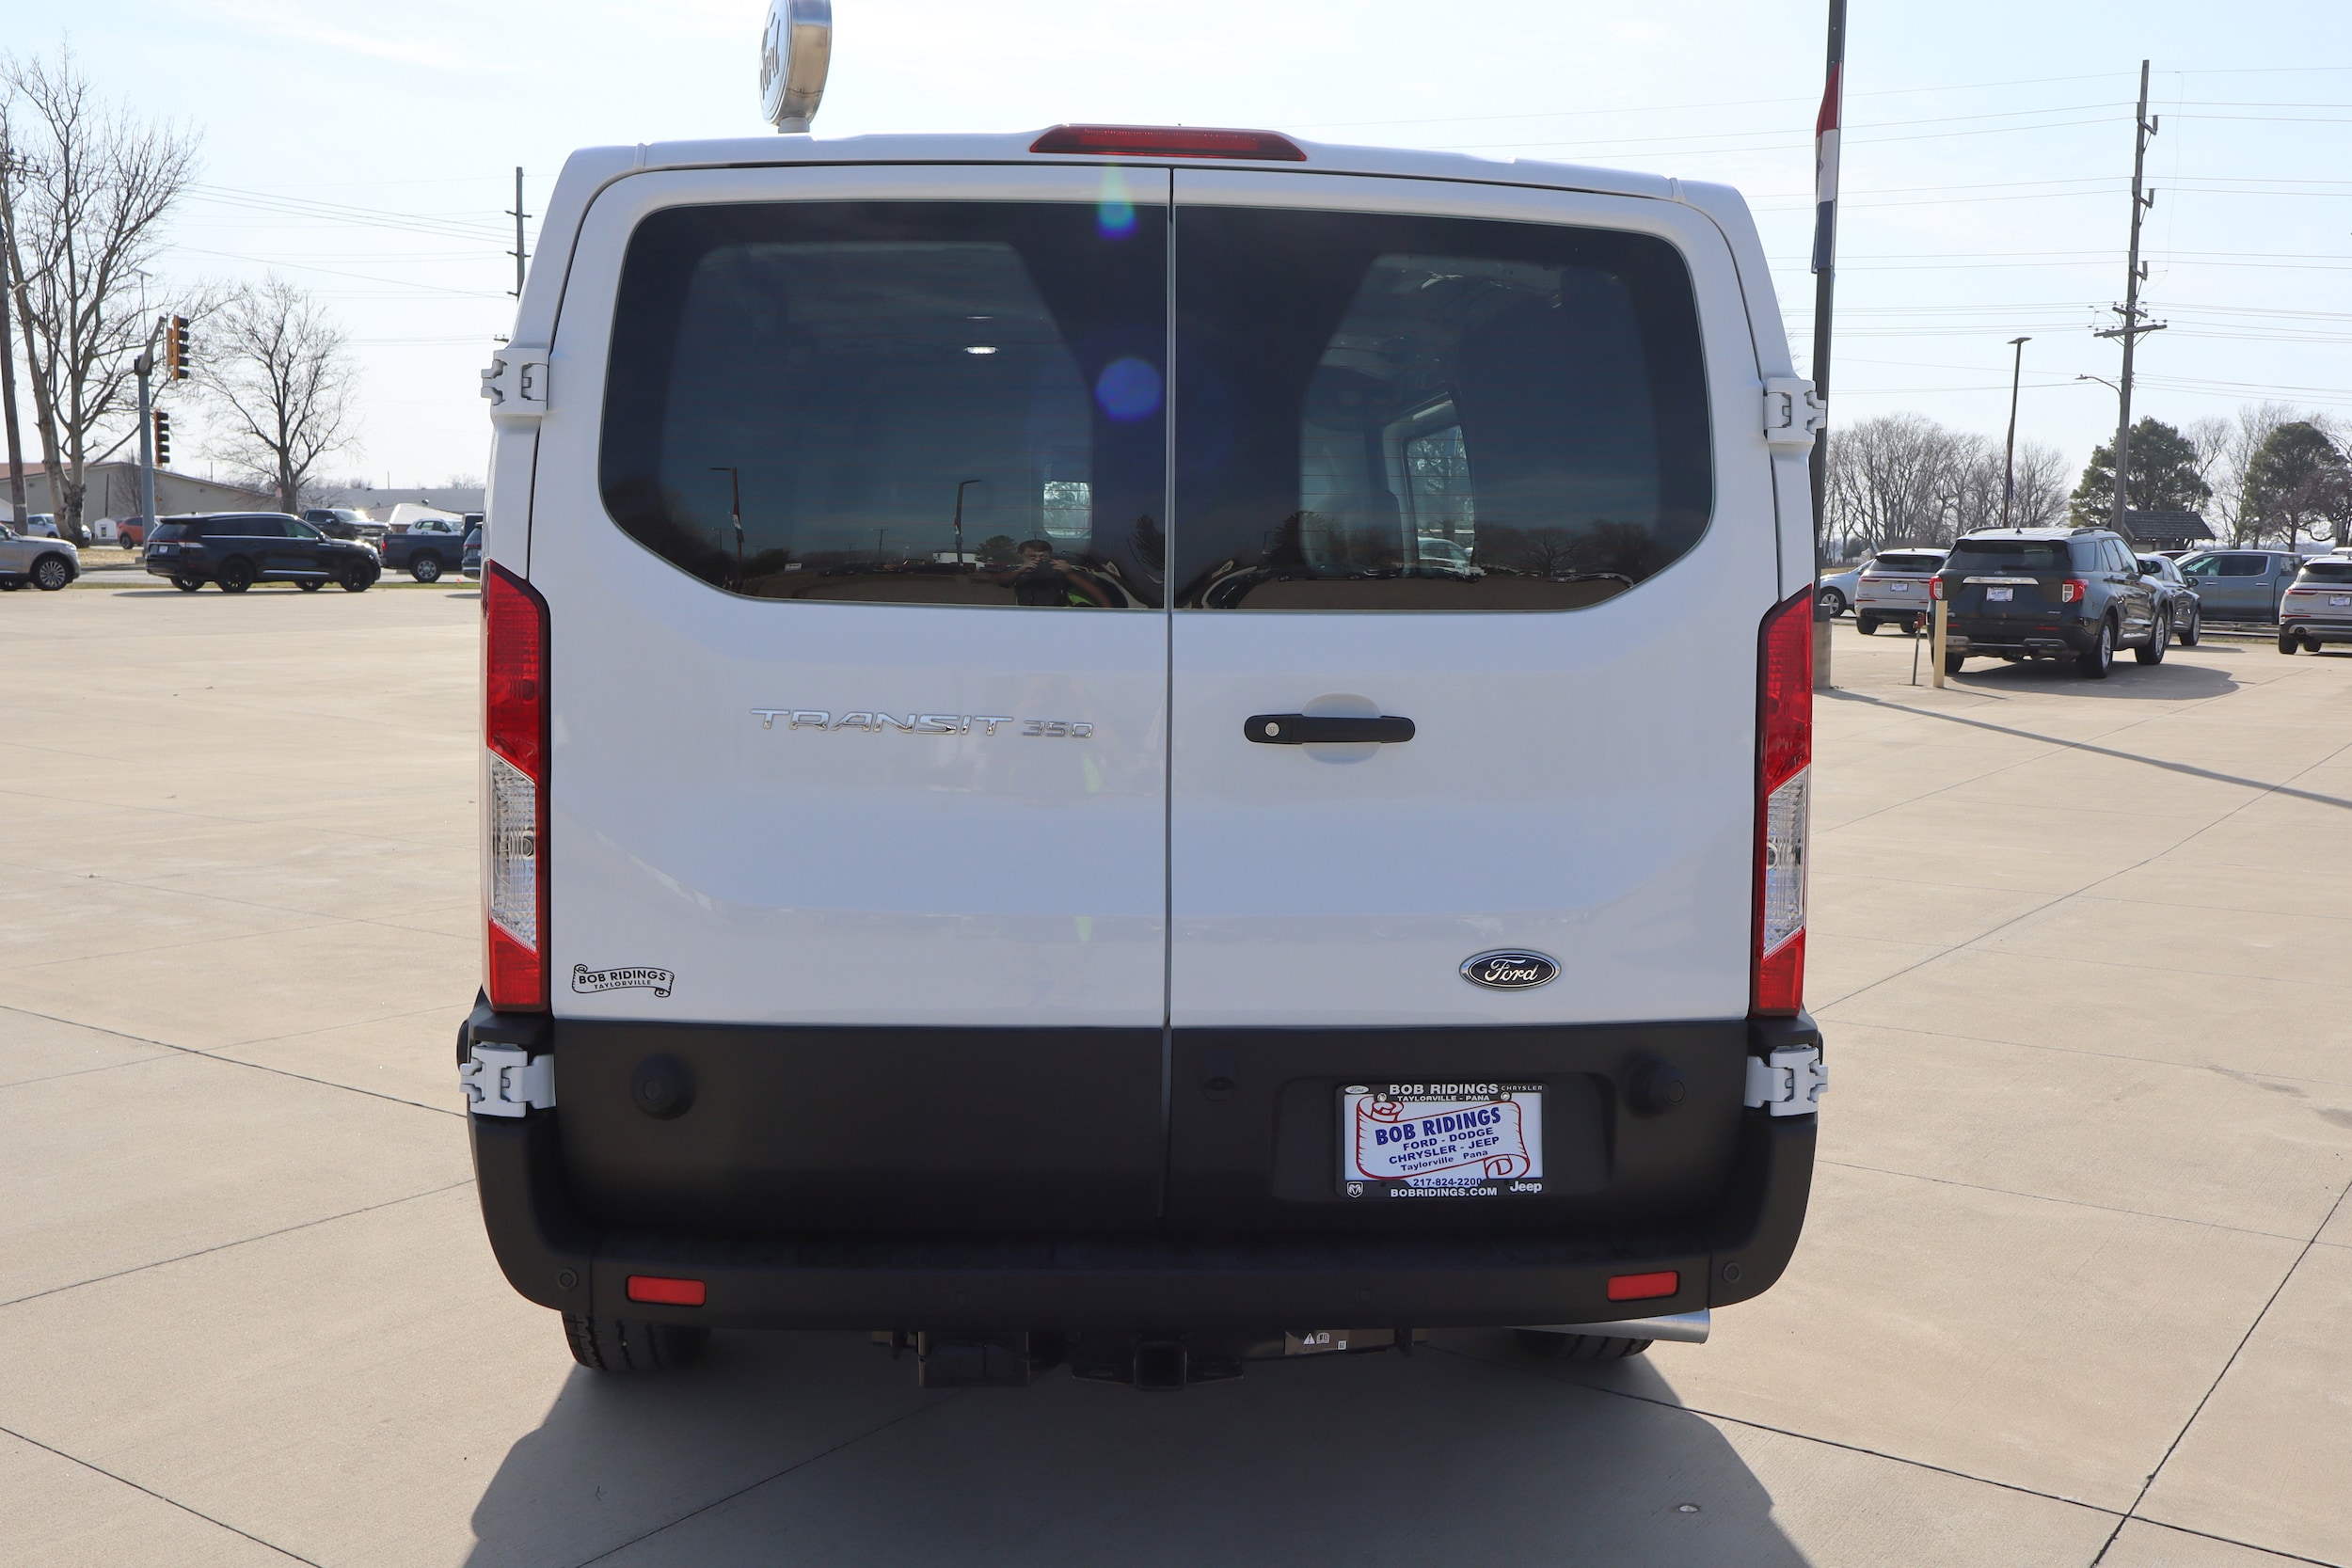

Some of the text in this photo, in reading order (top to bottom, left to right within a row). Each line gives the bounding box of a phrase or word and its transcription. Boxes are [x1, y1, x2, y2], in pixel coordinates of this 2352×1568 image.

[751, 708, 1094, 738] TRANSIT 350
[579, 970, 666, 984] BOB RIDINGS
[1484, 958, 1540, 981] Ford
[594, 979, 651, 990] TAYLORVILLE
[1389, 1084, 1499, 1095] BOB RIDINGS
[1375, 1107, 1501, 1146] BOB RIDINGS
[1403, 1138, 1438, 1151] FORD
[1449, 1127, 1494, 1142] DODGE
[1389, 1145, 1457, 1164] CHRYSLER
[1468, 1136, 1500, 1149] JEEP
[1401, 1149, 1488, 1171] Taylorville Pana
[1413, 1178, 1483, 1187] 217-824-2200
[1510, 1180, 1543, 1194] Jeep
[1391, 1187, 1498, 1197] BOBRIDINGS.COM
